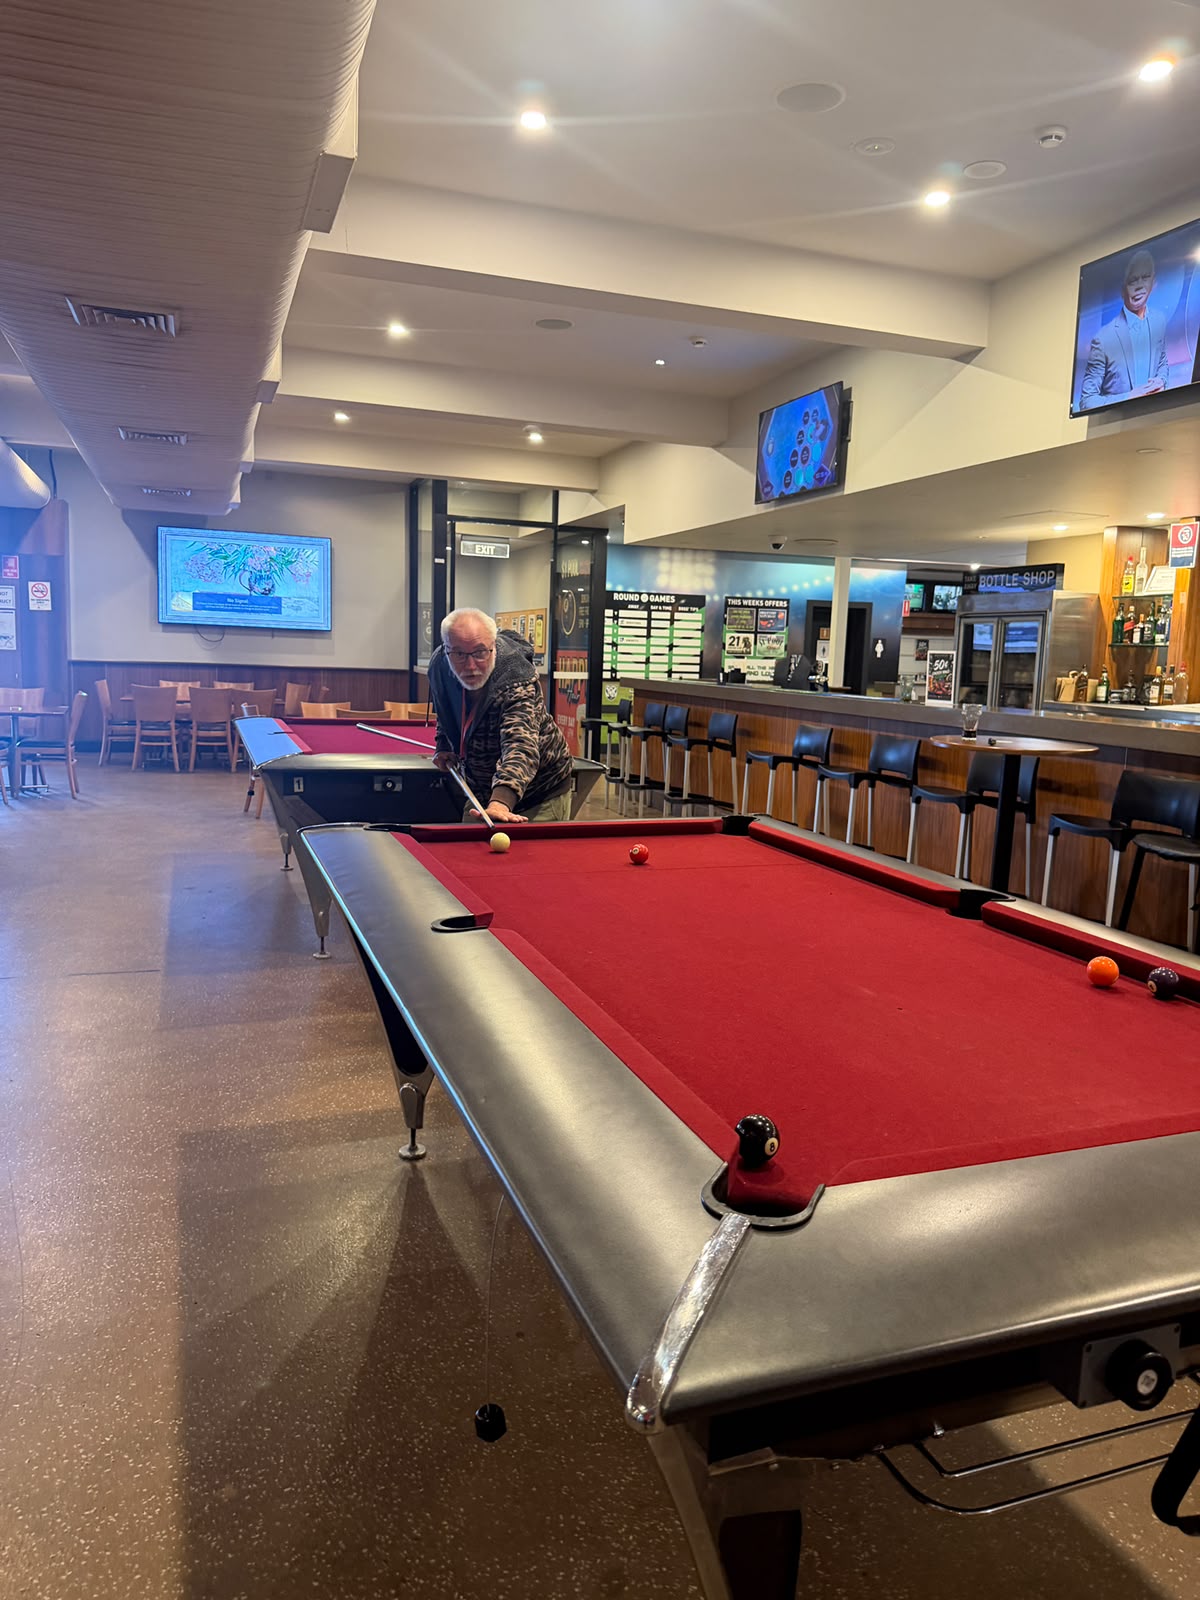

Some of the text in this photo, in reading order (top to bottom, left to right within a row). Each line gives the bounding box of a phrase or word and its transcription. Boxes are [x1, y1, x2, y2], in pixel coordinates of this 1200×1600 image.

[475, 544, 495, 555] EXIT
[979, 570, 1056, 587] BOTTLE SHOP
[613, 592, 676, 603] ROUND GAMES
[728, 598, 741, 606] THIS
[764, 600, 788, 608] OFFERS
[728, 636, 740, 646] 21
[559, 657, 588, 692] HAPP
[770, 1142, 775, 1152] 8
